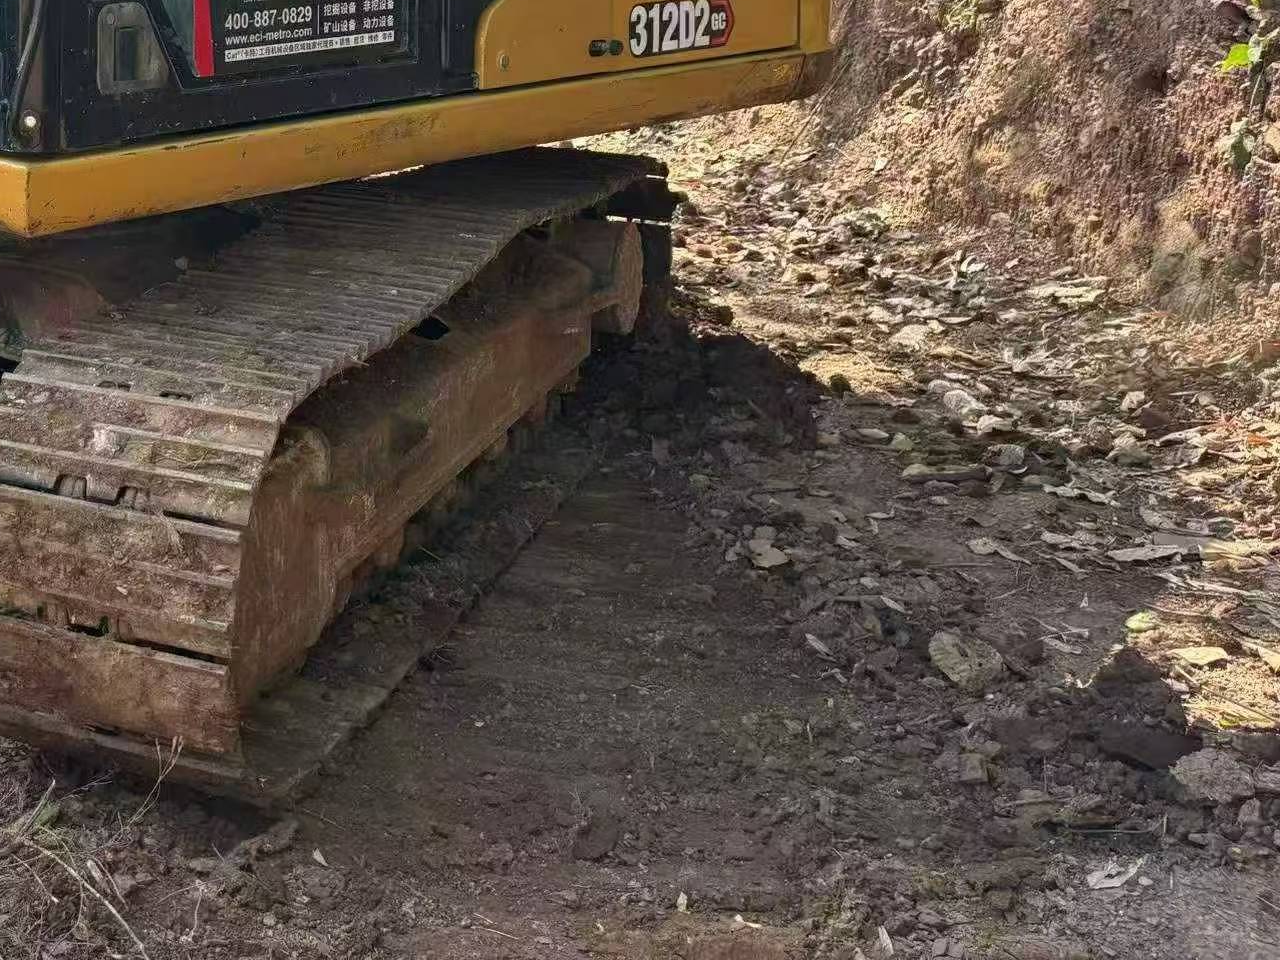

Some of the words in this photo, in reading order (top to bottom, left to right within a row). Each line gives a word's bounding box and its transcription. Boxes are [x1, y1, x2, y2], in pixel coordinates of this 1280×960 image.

[225, 6, 312, 30] 400-887-0829
[323, 3, 356, 16] 挖掘设备
[323, 20, 356, 33] 矿山设备
[363, 15, 394, 29] 动力设备
[711, 12, 726, 31] GC
[225, 27, 313, 45] www.eci-metro.com
